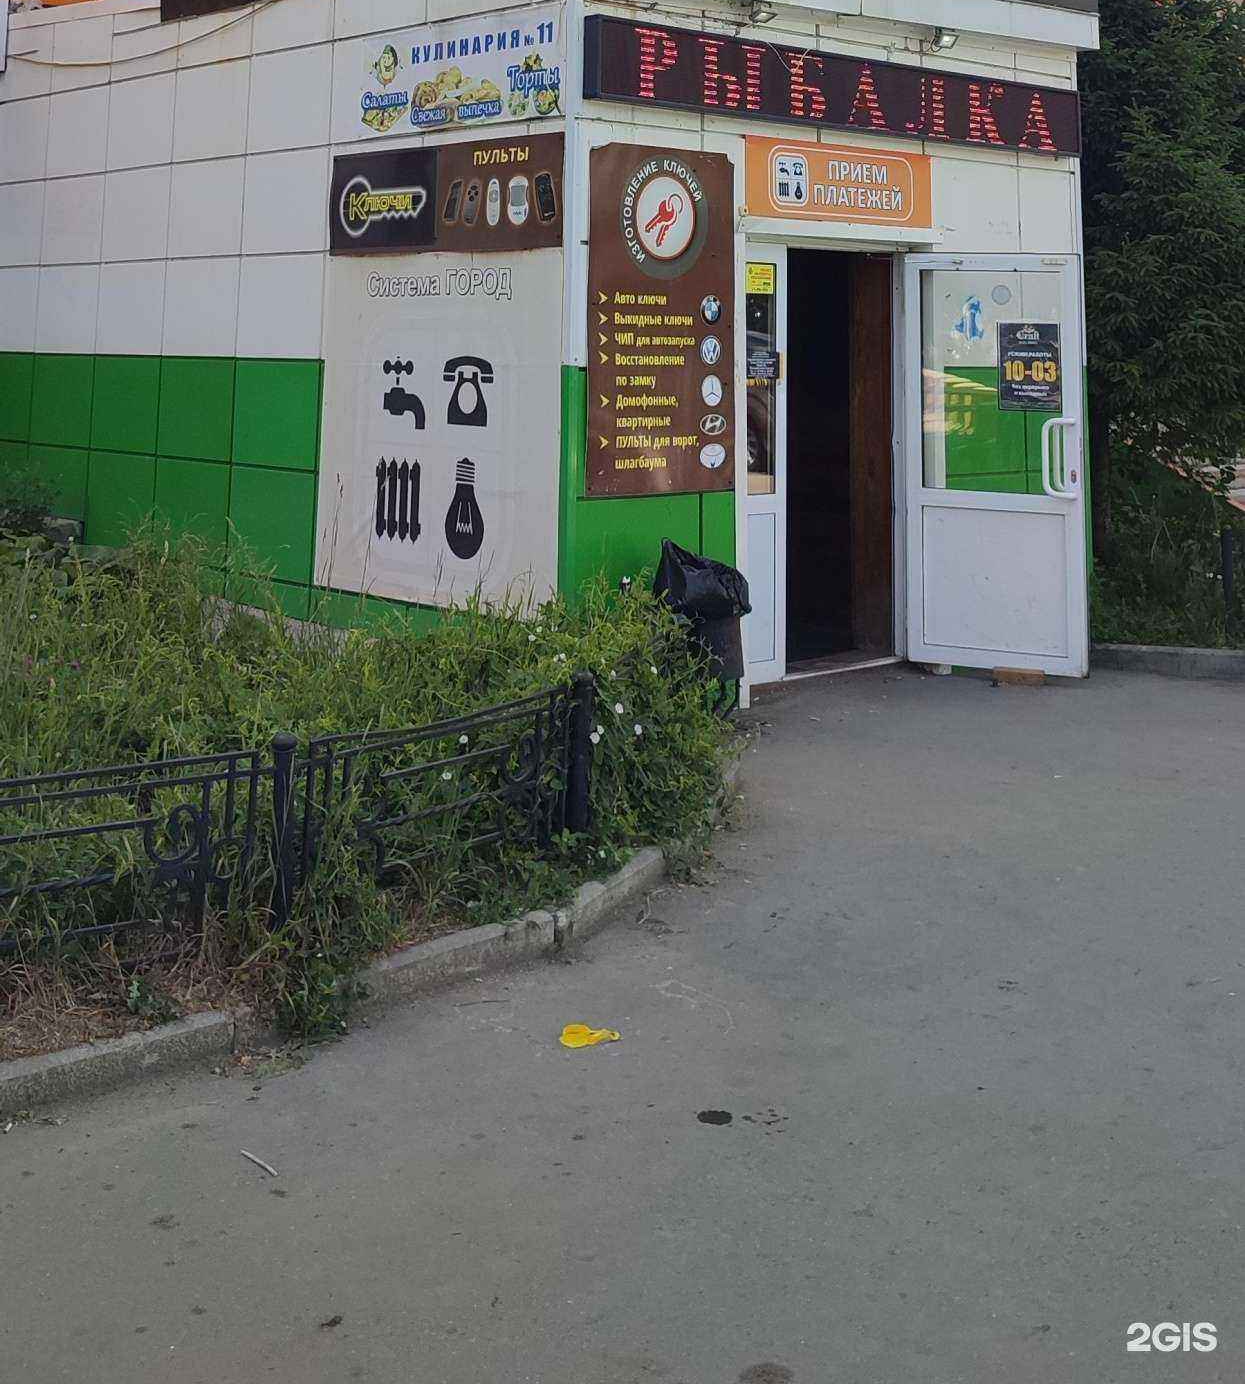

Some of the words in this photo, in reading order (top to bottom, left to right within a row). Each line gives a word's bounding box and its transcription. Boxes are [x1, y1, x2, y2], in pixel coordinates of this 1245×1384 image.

[411, 29, 520, 65] КУЛИНАРИЯ
[536, 21, 554, 44] 11
[507, 66, 560, 97] Торты
[633, 27, 1058, 152] РЫБАЛКА
[361, 90, 409, 109] Салаты
[410, 106, 447, 123] Свежая
[457, 100, 501, 118] выпечка
[473, 146, 529, 166] ПУЛЬТЫ
[827, 159, 889, 186] ПРИЕМ
[813, 183, 903, 211] ПЛАТЕЖЕЙ
[623, 160, 659, 264] ИЗГОТОВЛЕНИЕ
[663, 159, 702, 202] КЛЮЧЕЙ
[367, 271, 441, 297] Система
[445, 267, 512, 300] ГОРОД
[614, 291, 634, 305] Авто
[637, 295, 667, 306] ключи
[614, 312, 662, 327] Выкидные
[664, 316, 693, 327] ключи
[614, 332, 634, 346] ЧИП
[636, 337, 650, 347] для
[652, 336, 695, 349] автозапуска
[615, 353, 685, 366] Восстановление
[1003, 360, 1057, 382] 10-03
[616, 376, 627, 386] по
[629, 375, 656, 389] замку
[616, 394, 679, 410] Домофонные,
[616, 415, 671, 430] квартирные
[616, 436, 652, 449] ПУЛЬТЫ
[654, 437, 670, 448] для
[615, 455, 667, 471] шлагбаума
